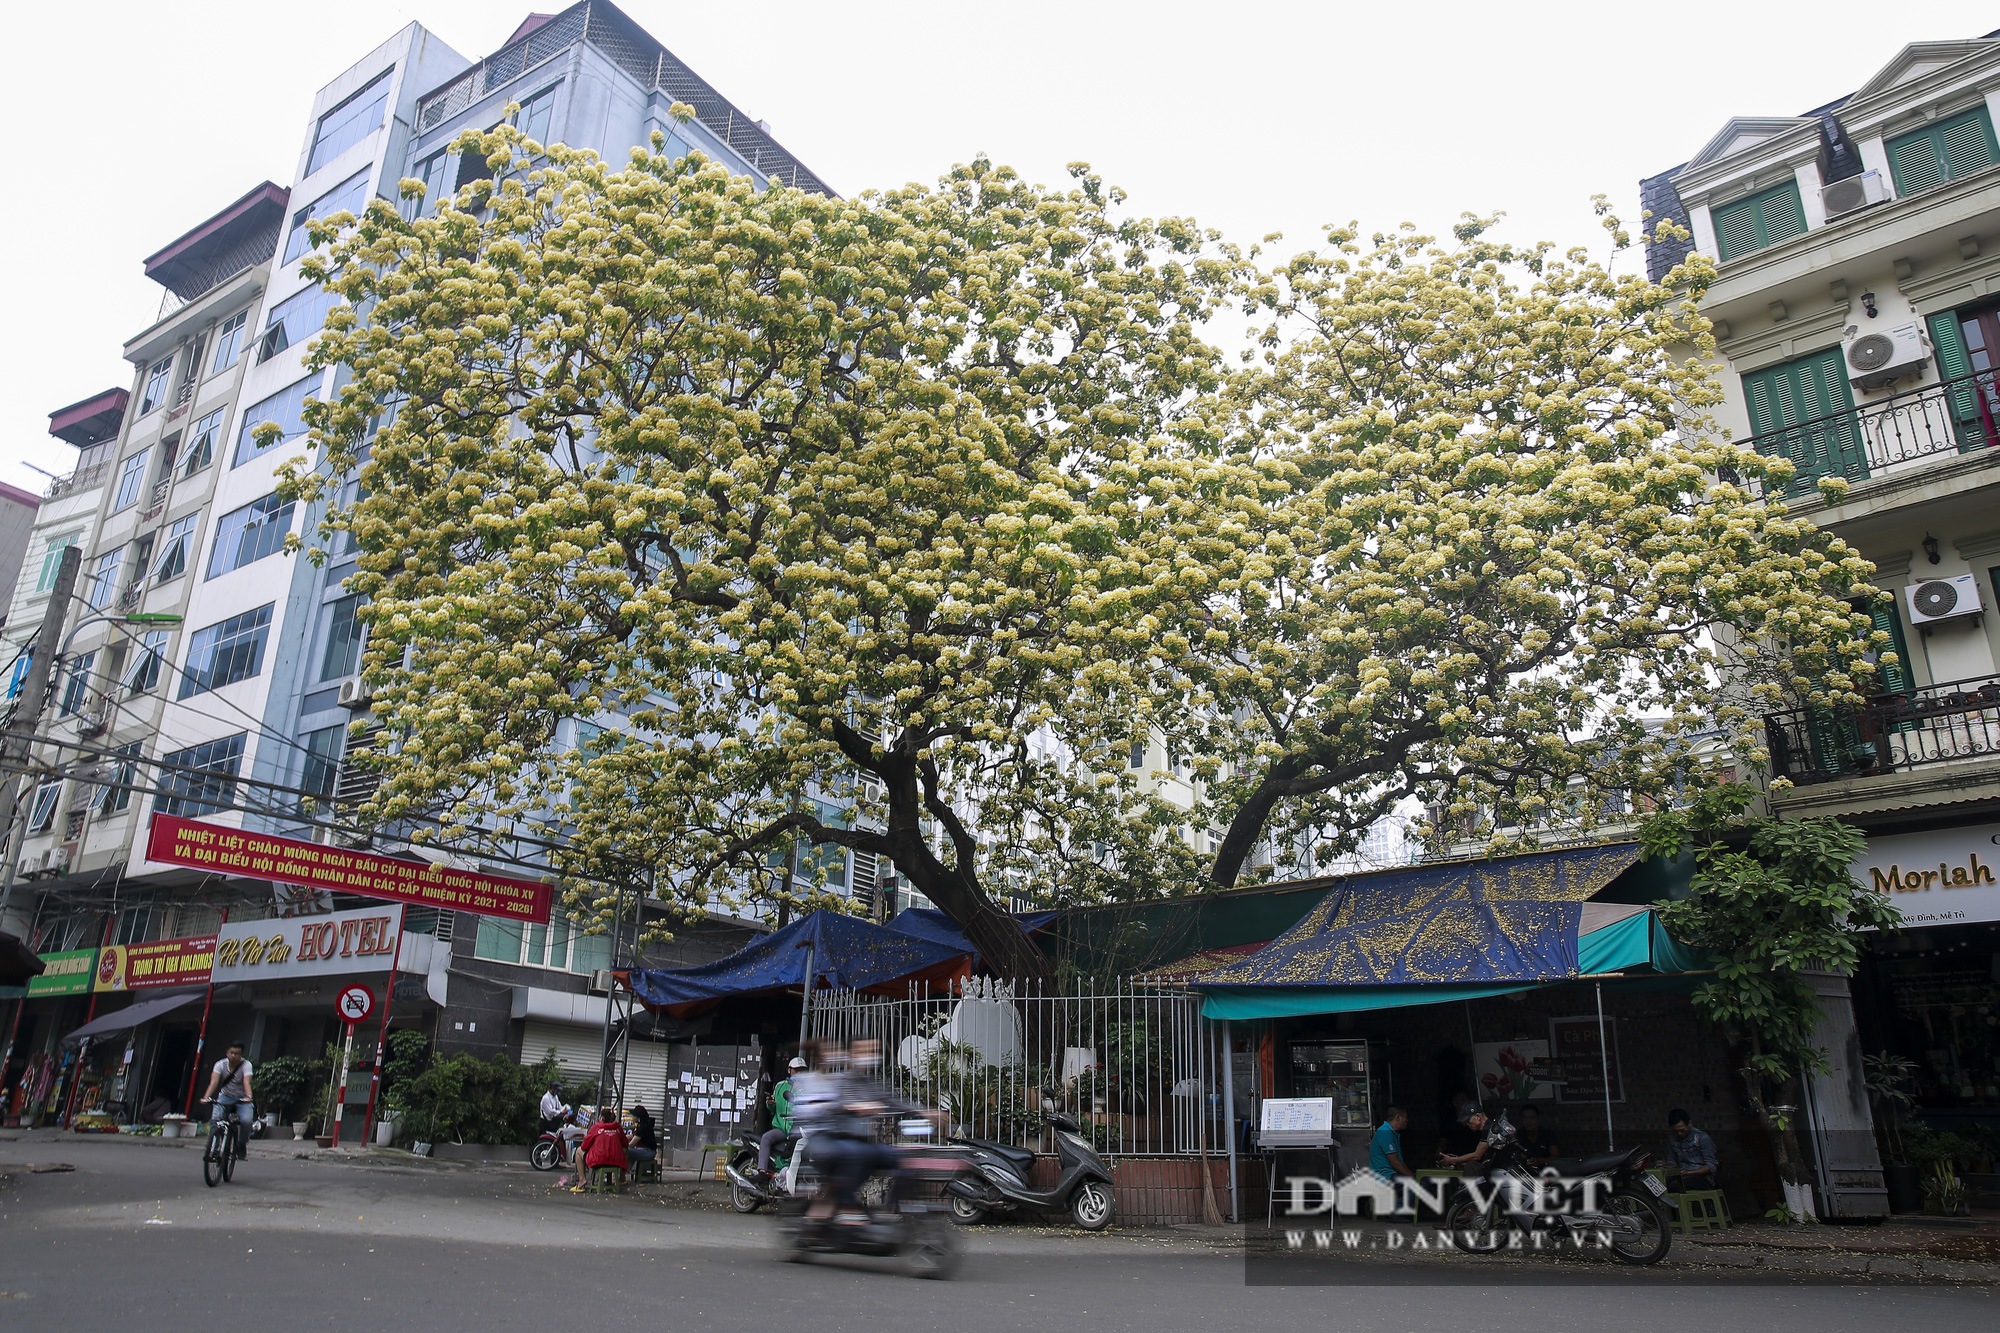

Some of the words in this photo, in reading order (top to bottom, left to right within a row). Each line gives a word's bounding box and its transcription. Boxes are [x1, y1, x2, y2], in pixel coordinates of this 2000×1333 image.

[177, 828, 216, 846] NHIỆT
[218, 835, 245, 851] LIỆT
[247, 840, 280, 856] CHÀO
[283, 845, 319, 862] MỪNG
[322, 852, 352, 868] NGÀY
[355, 857, 378, 873] BẦU
[381, 861, 397, 876] CỬ
[398, 866, 416, 881] ĐẠI
[445, 874, 472, 890] QUỐC
[474, 879, 492, 894] HỘI
[493, 883, 519, 898] KHÓA
[521, 889, 535, 900] XV
[1868, 852, 1997, 893] Moriah
[174, 844, 191, 858] VÀ
[194, 848, 217, 864] ĐẠI
[219, 850, 249, 867] BIỂU
[252, 857, 273, 872] HỘI
[276, 860, 310, 877] ĐỒNG
[312, 867, 345, 883] NHÂN
[347, 873, 371, 888] DÂN
[373, 877, 396, 891] CÁC
[398, 879, 420, 895] CẤP
[422, 886, 456, 902] NHIỆM
[458, 891, 473, 904] KỲ
[474, 895, 497, 908] 2021
[506, 901, 534, 915] 2026!
[1903, 915, 1915, 924] Mỹ
[1917, 912, 1938, 921] Đình,
[1953, 910, 1965, 919] Trì
[296, 916, 395, 961] HOTEL
[179, 952, 214, 972] HOLDINGS
[395, 986, 424, 998] HOTEL
[1563, 1030, 1580, 1044] Cà
